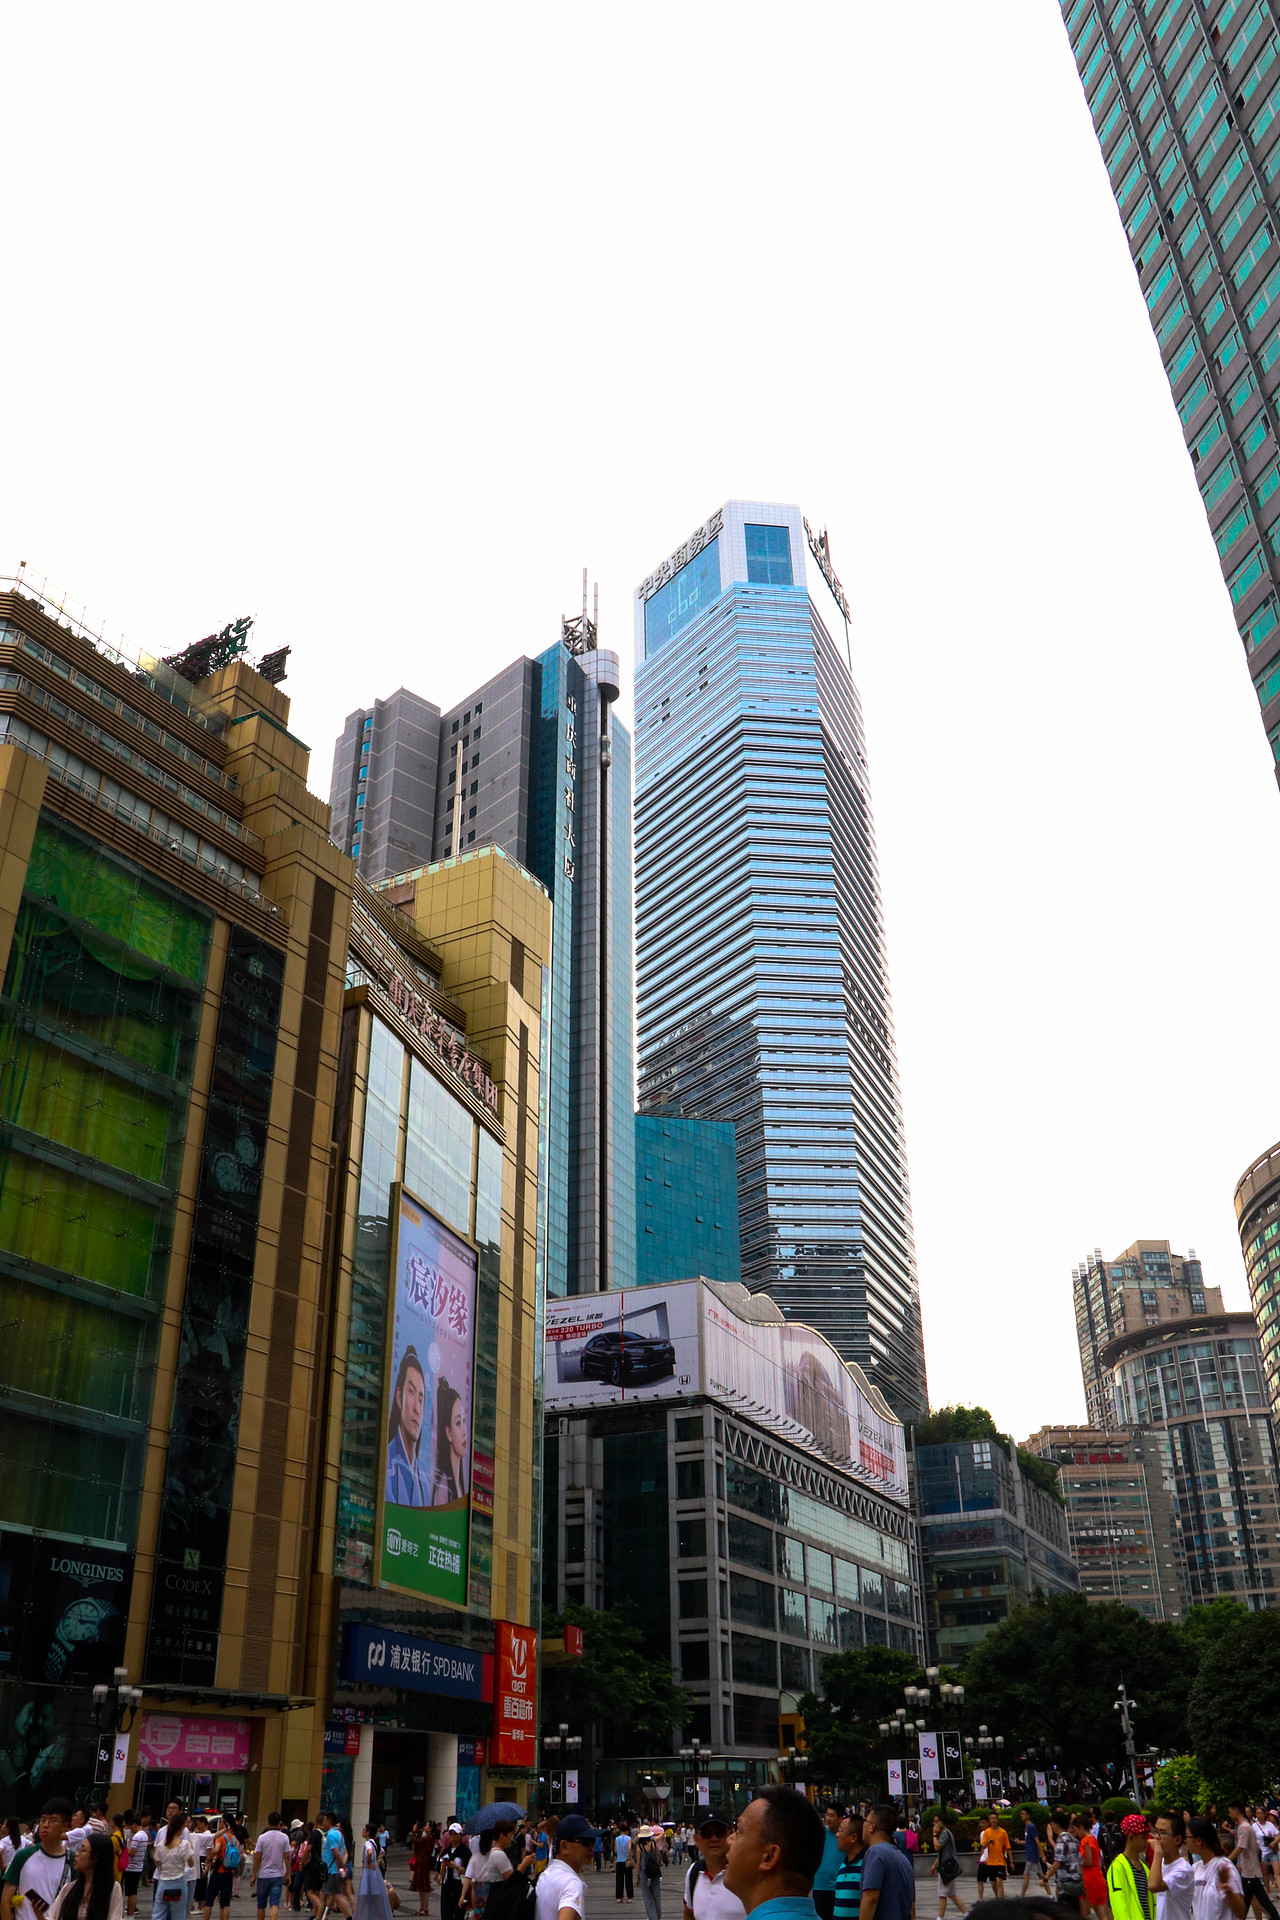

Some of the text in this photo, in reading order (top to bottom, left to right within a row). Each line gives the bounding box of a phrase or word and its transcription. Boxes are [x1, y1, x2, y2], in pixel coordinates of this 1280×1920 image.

[638, 508, 724, 601] 中央商务区
[564, 693, 577, 883] 重庆商社大厦
[575, 1322, 603, 1331] TURBO
[858, 1422, 883, 1448] VEZEL
[401, 1538, 419, 1557] 爱奇艺
[428, 1545, 461, 1574] 正在热播
[50, 1557, 124, 1582] LONGINES
[390, 1645, 475, 1682] 浦发银行 SPD BANK
[511, 1680, 527, 1694] CBEST
[503, 1696, 533, 1720] 重百超市
[98, 1749, 109, 1762] 5G
[116, 1749, 125, 1760] 5G
[923, 1748, 936, 1758] 5G
[946, 1746, 959, 1759] 5G
[890, 1771, 900, 1779] 5G
[908, 1770, 918, 1778] 5G
[552, 1780, 561, 1789] 5G
[568, 1780, 576, 1788] 5G
[991, 1778, 1000, 1786] 5G
